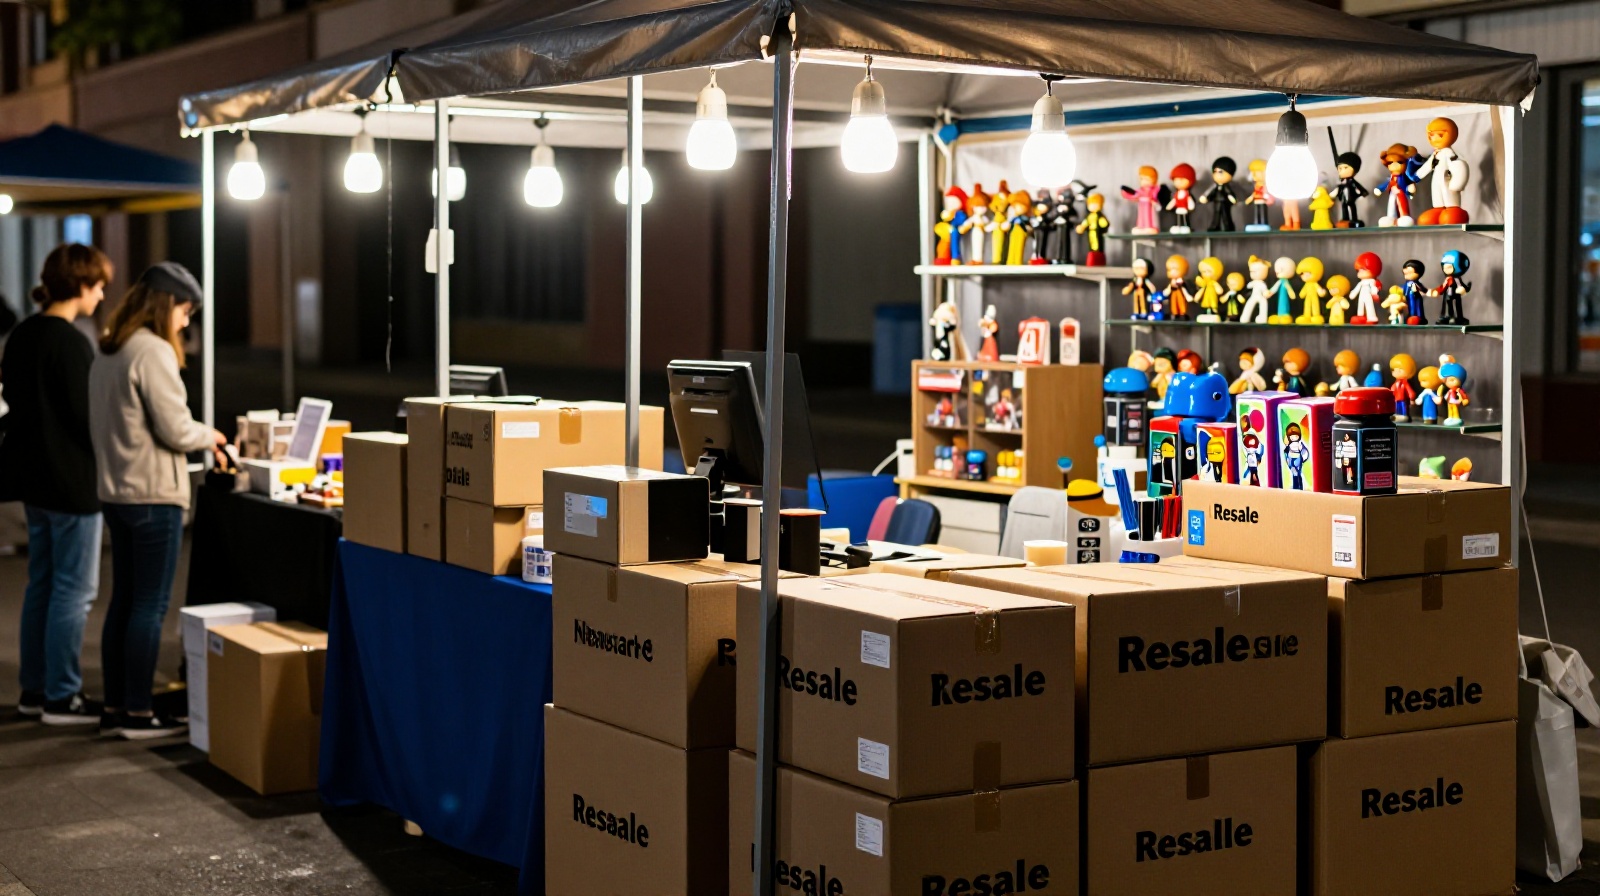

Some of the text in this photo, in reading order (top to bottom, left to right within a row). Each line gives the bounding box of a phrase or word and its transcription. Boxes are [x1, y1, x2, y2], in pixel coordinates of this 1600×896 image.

[1214, 503, 1259, 524] Resale
[931, 663, 1046, 707] Resale
[1385, 677, 1482, 715] Resale
[1361, 777, 1463, 819] Resale
[751, 842, 844, 896] esale
